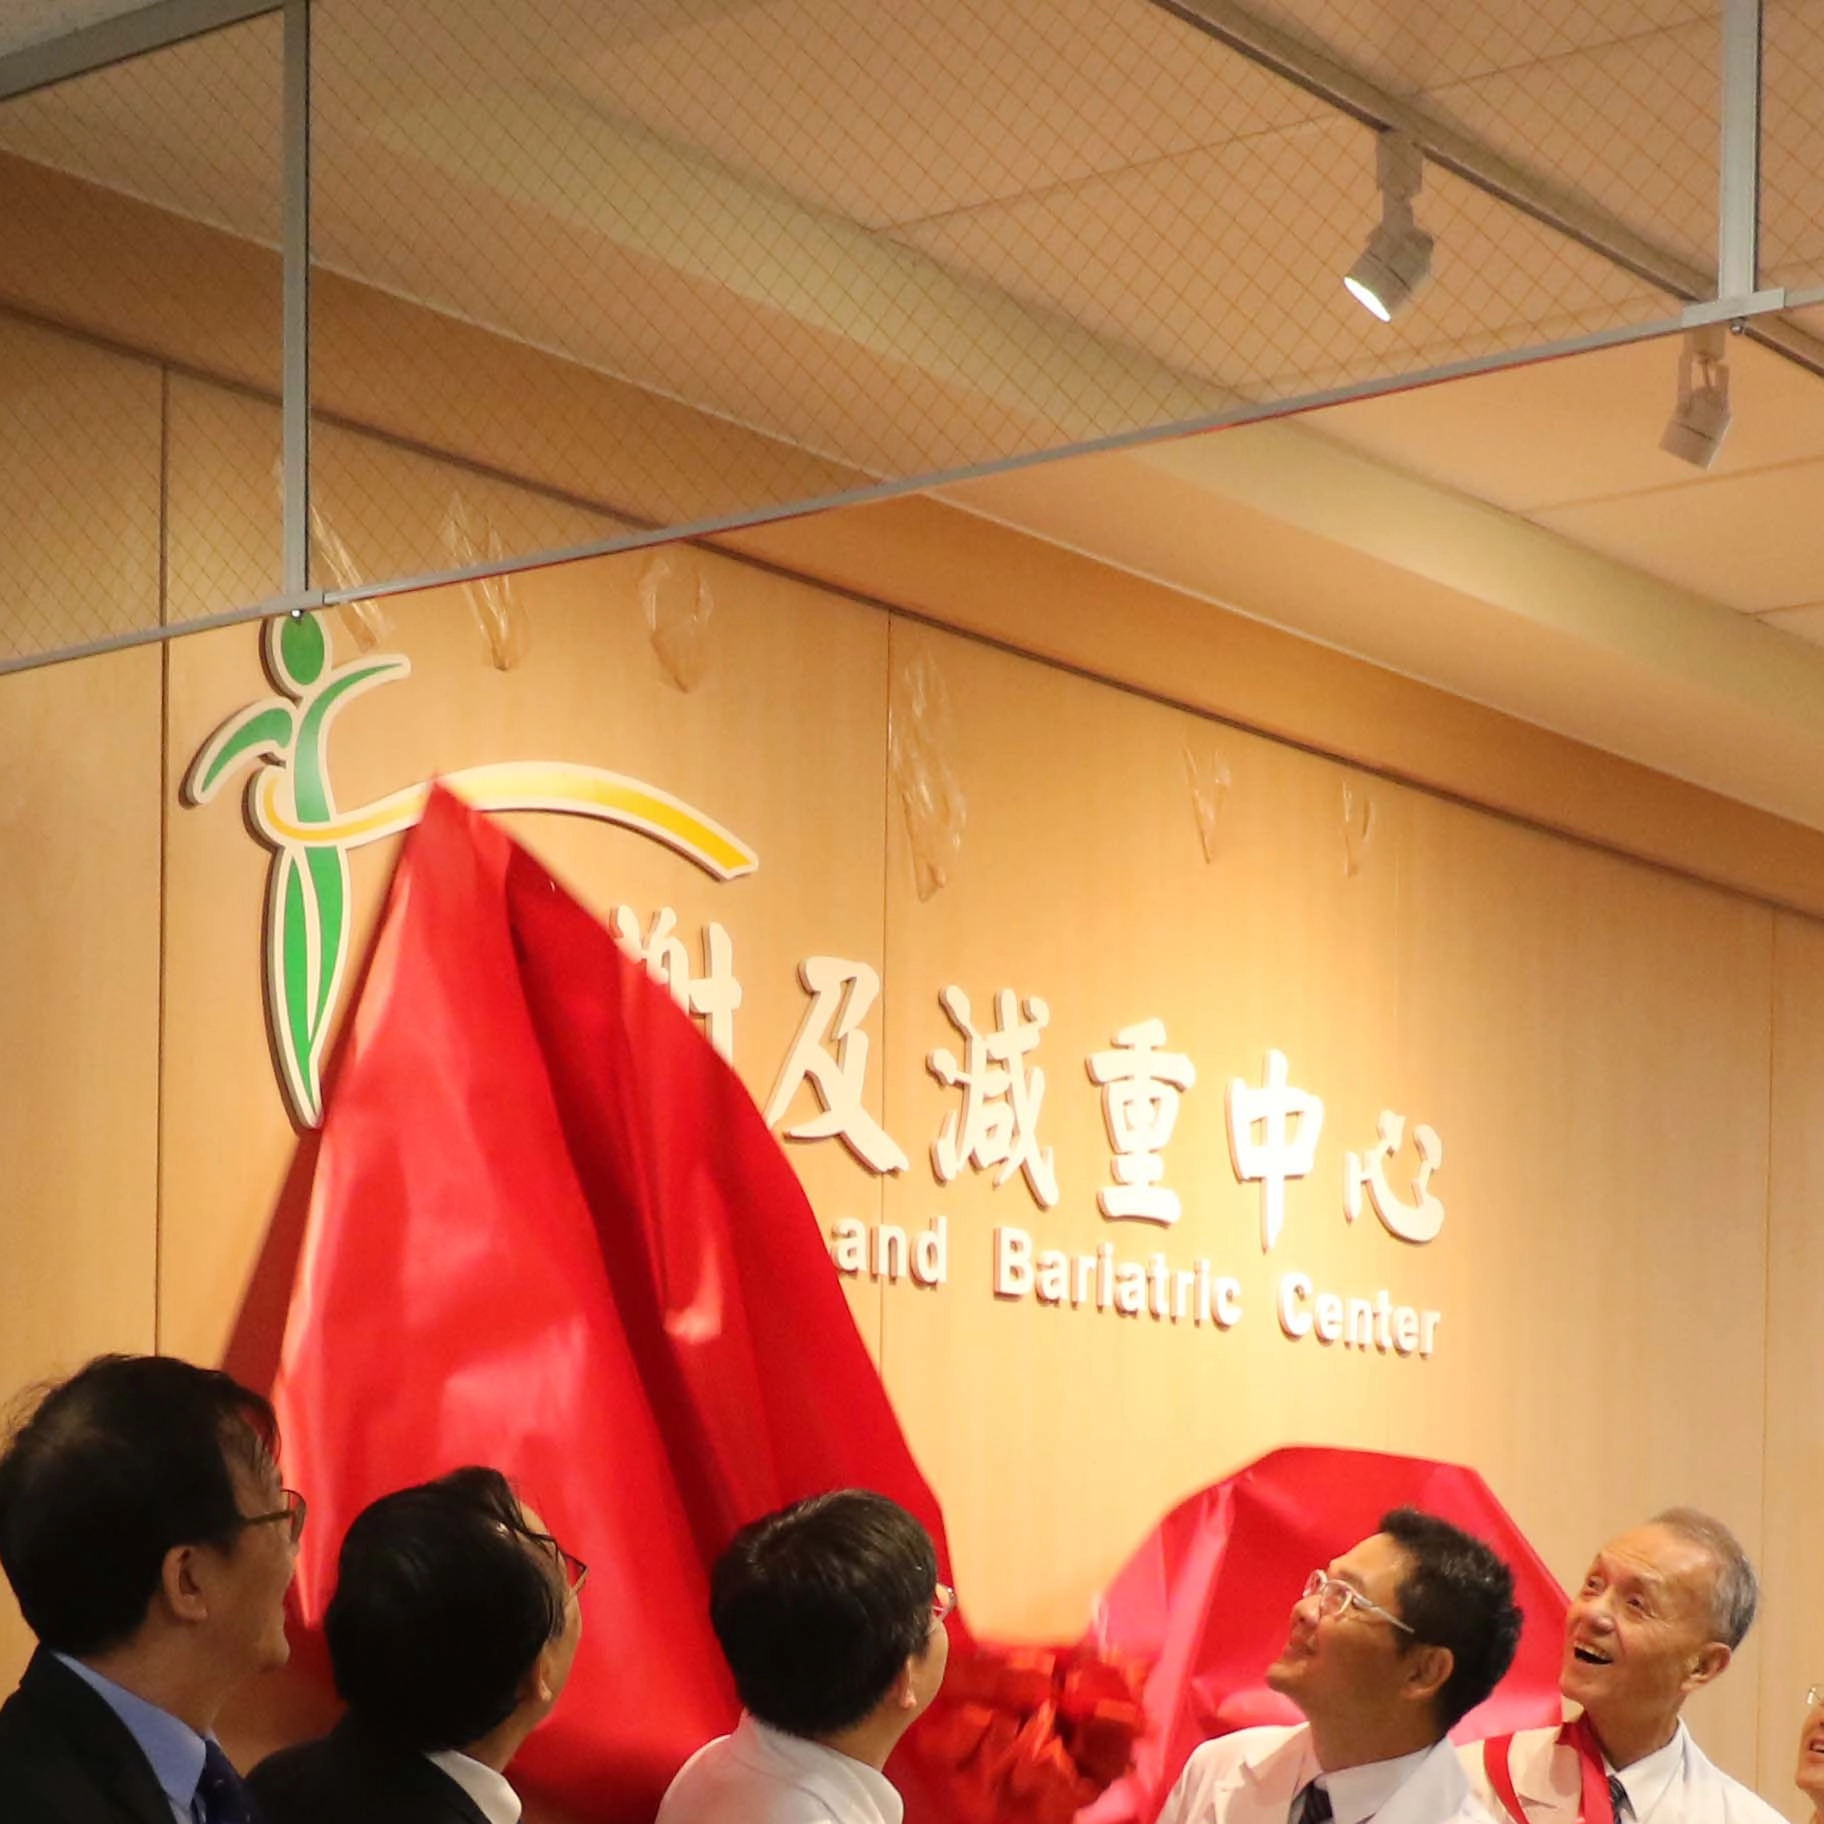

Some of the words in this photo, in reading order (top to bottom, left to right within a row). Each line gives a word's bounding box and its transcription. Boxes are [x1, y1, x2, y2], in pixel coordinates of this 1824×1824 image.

[831, 1216, 948, 1286] and
[992, 1226, 1242, 1328] Bariatric
[1277, 1271, 1441, 1357] Center
